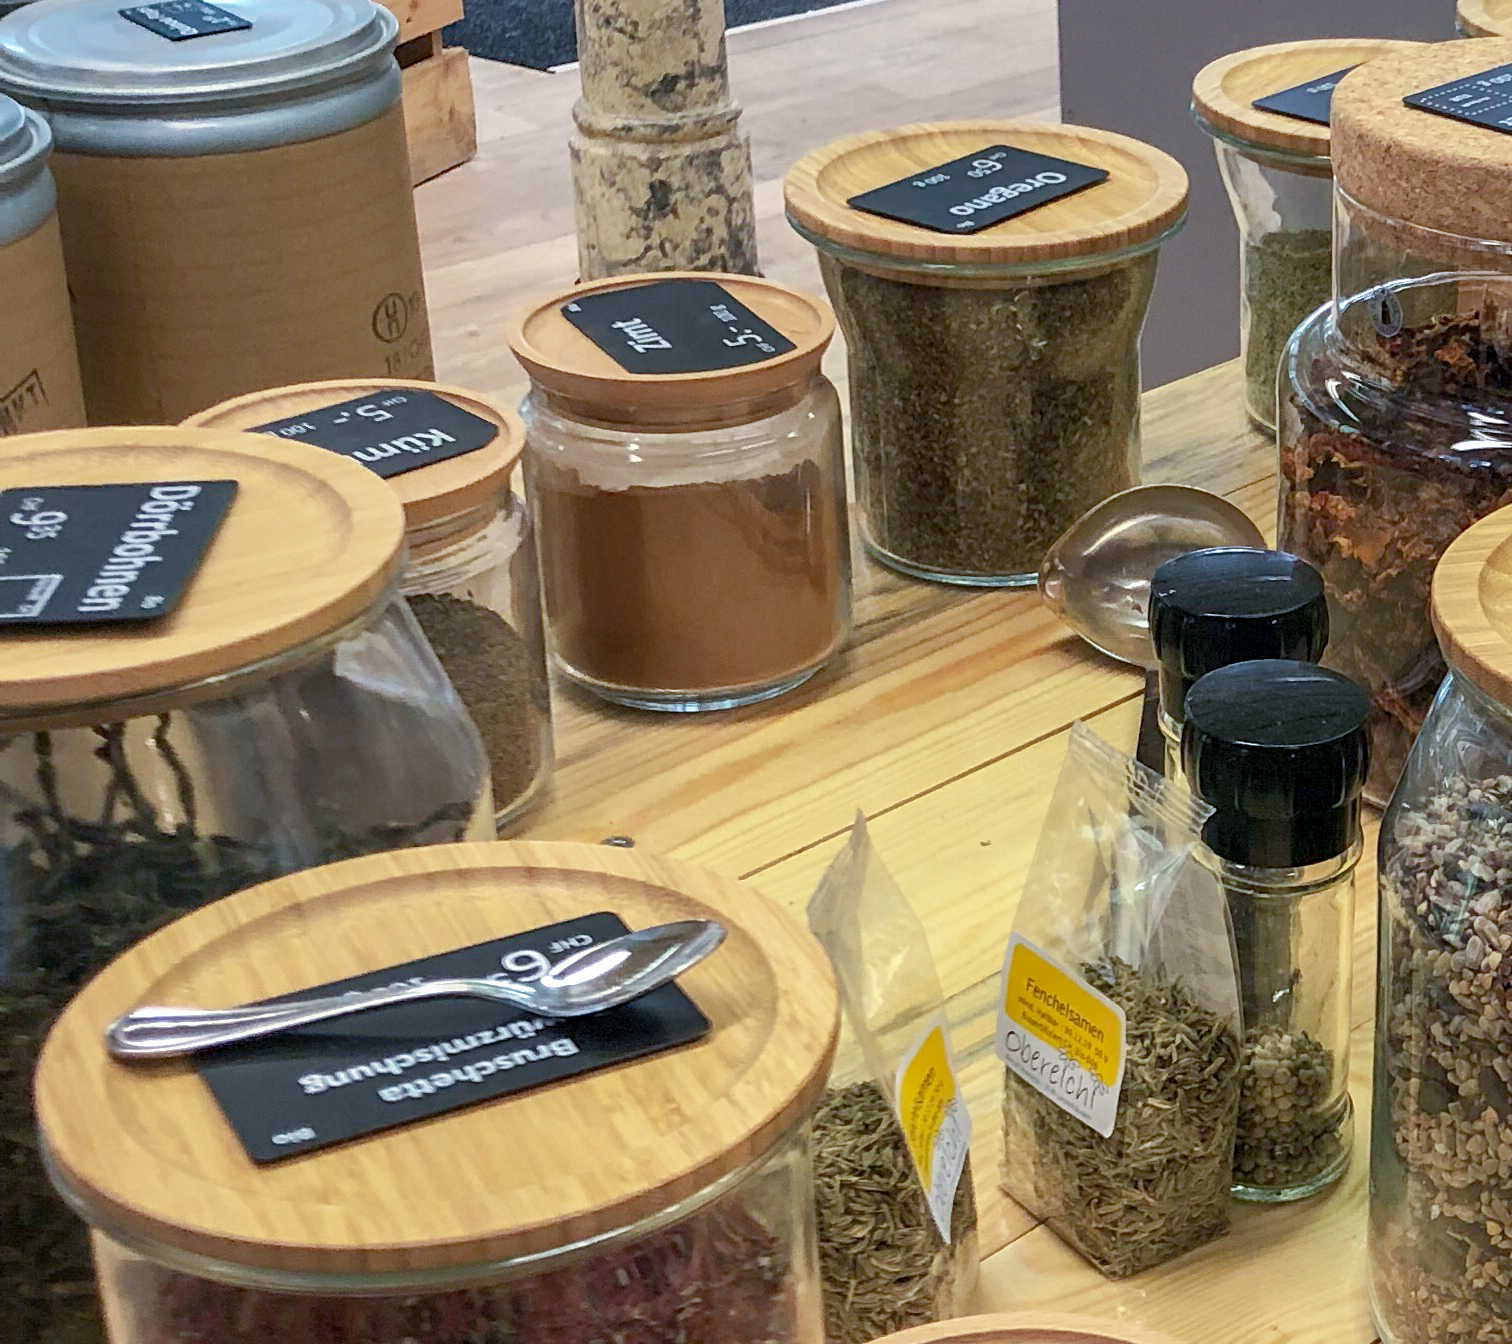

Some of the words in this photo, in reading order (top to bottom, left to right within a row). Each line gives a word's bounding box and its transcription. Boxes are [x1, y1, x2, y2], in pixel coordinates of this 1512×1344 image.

[948, 171, 1067, 217] Oregano
[611, 317, 674, 354] Zimt
[77, 484, 202, 613] Dörrbohnen
[548, 933, 594, 955] CHF
[1025, 976, 1105, 1045] Fenchelsamen
[376, 1037, 581, 1103] Bruschetta
[270, 1126, 316, 1145] Bio
